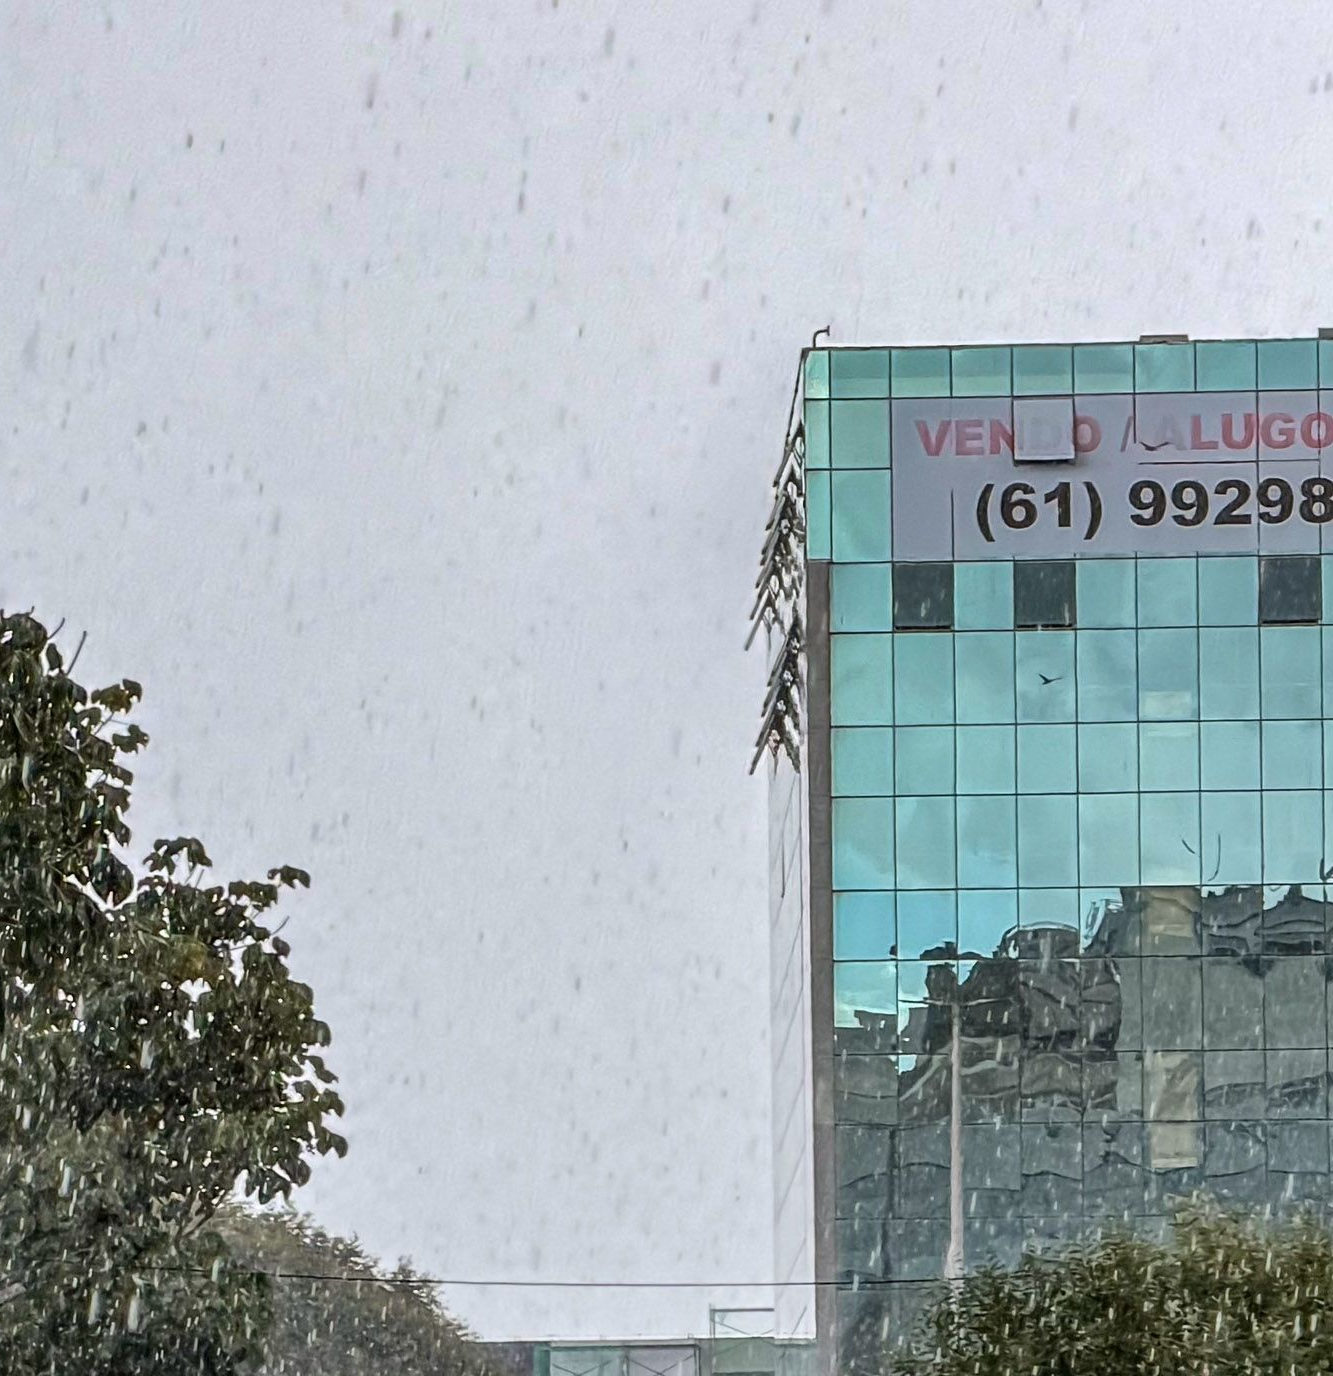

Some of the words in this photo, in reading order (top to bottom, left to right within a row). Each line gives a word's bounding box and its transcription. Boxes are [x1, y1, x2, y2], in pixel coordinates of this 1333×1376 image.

[1153, 411, 1333, 451] ALUGO
[976, 480, 1103, 543] (61)
[1128, 477, 1333, 527] 99298
